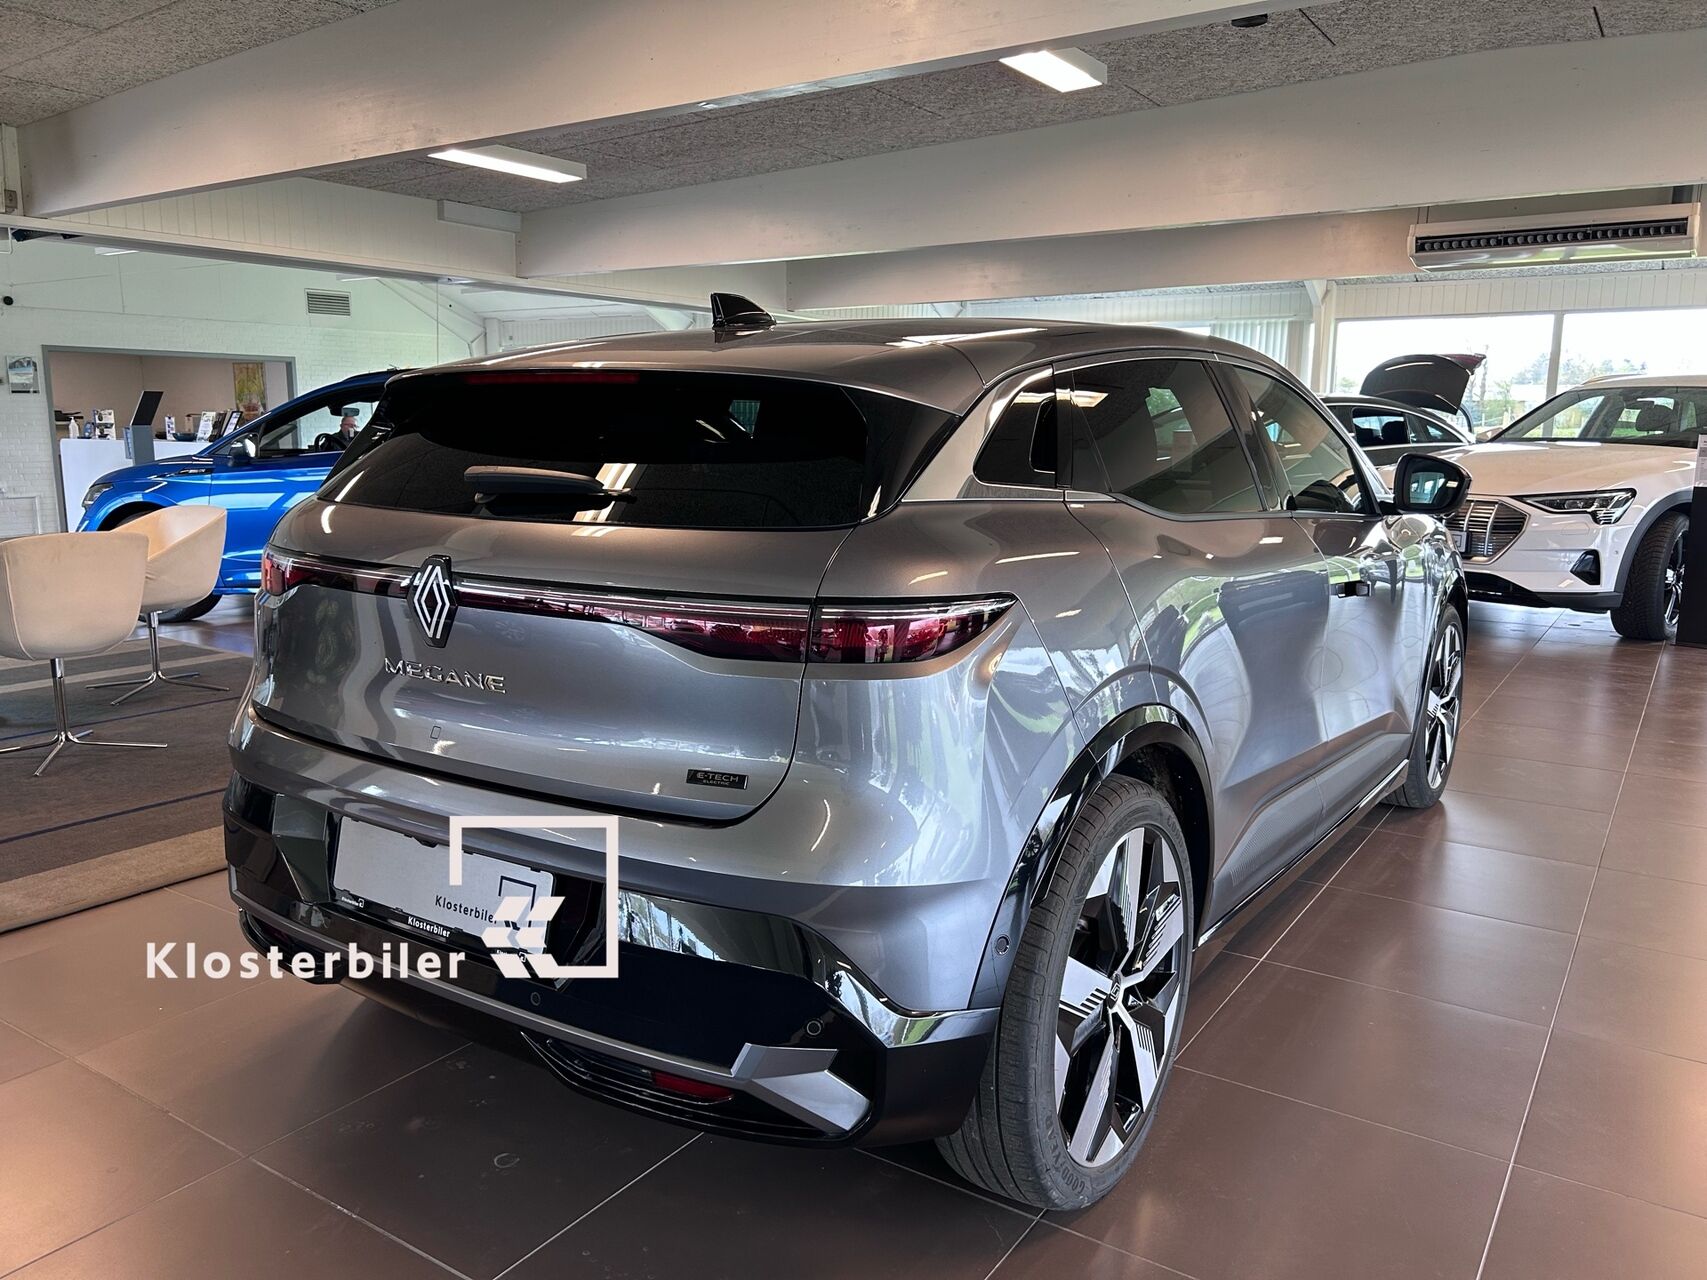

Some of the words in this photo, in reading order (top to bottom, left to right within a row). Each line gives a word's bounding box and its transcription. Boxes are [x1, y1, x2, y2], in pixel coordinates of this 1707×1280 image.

[384, 657, 506, 693] MEGANE
[696, 772, 739, 783] E-TECH
[435, 895, 498, 924] Klosterbile
[407, 915, 451, 937] Klosterbiler
